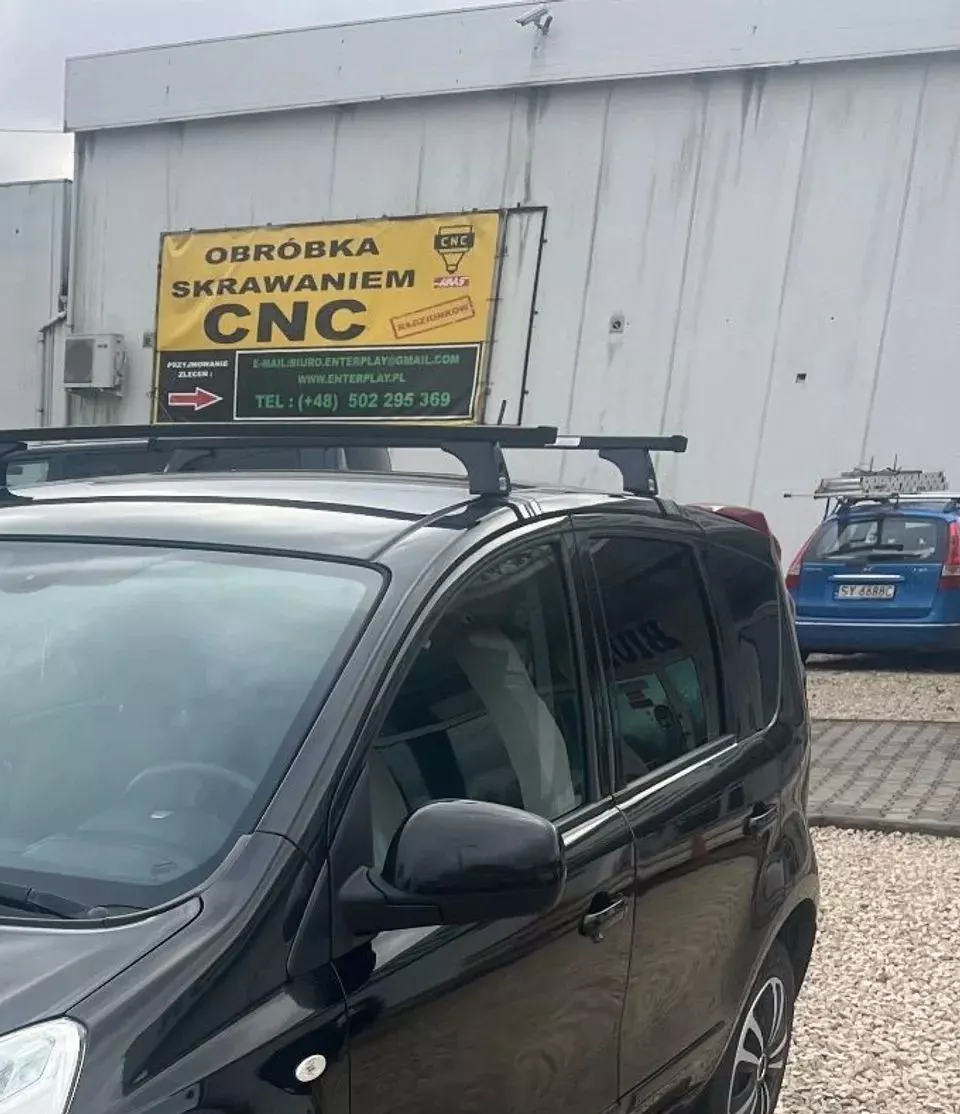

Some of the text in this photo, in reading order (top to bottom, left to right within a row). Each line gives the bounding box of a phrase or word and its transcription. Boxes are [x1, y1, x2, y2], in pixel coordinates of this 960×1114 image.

[204, 238, 380, 265] OBRÓBKA
[440, 236, 469, 247] CNC
[171, 269, 416, 298] SKRAWANIEM
[203, 299, 368, 345] CNC
[297, 373, 407, 384] WWW.ENTERPLAY.PL
[255, 394, 284, 409] TEL
[298, 393, 339, 412] (+48)
[348, 393, 378, 408] 502
[383, 392, 414, 408] 295
[419, 391, 451, 407] 369
